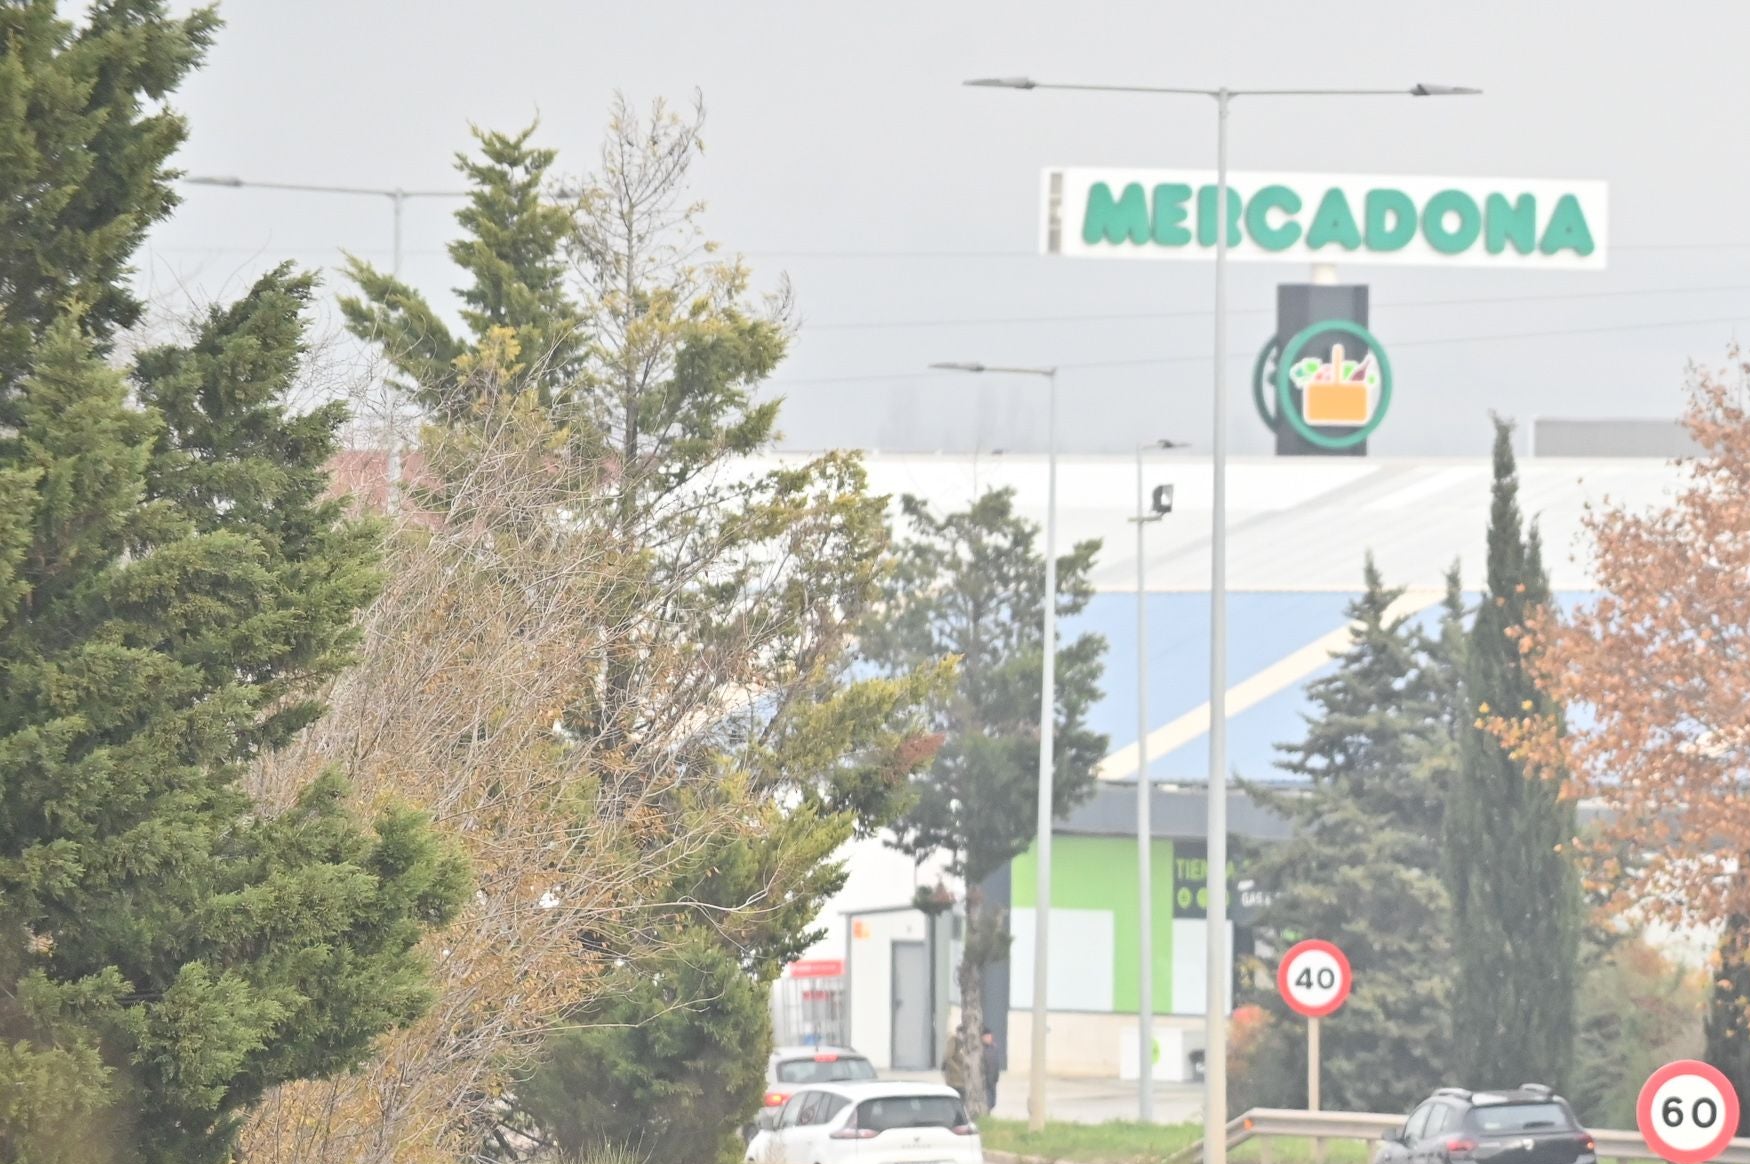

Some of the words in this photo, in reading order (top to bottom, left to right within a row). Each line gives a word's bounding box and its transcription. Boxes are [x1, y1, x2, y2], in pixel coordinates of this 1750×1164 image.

[1081, 181, 1595, 257] MERCADONA
[1295, 967, 1335, 990] 40
[1662, 1096, 1717, 1128] 60
